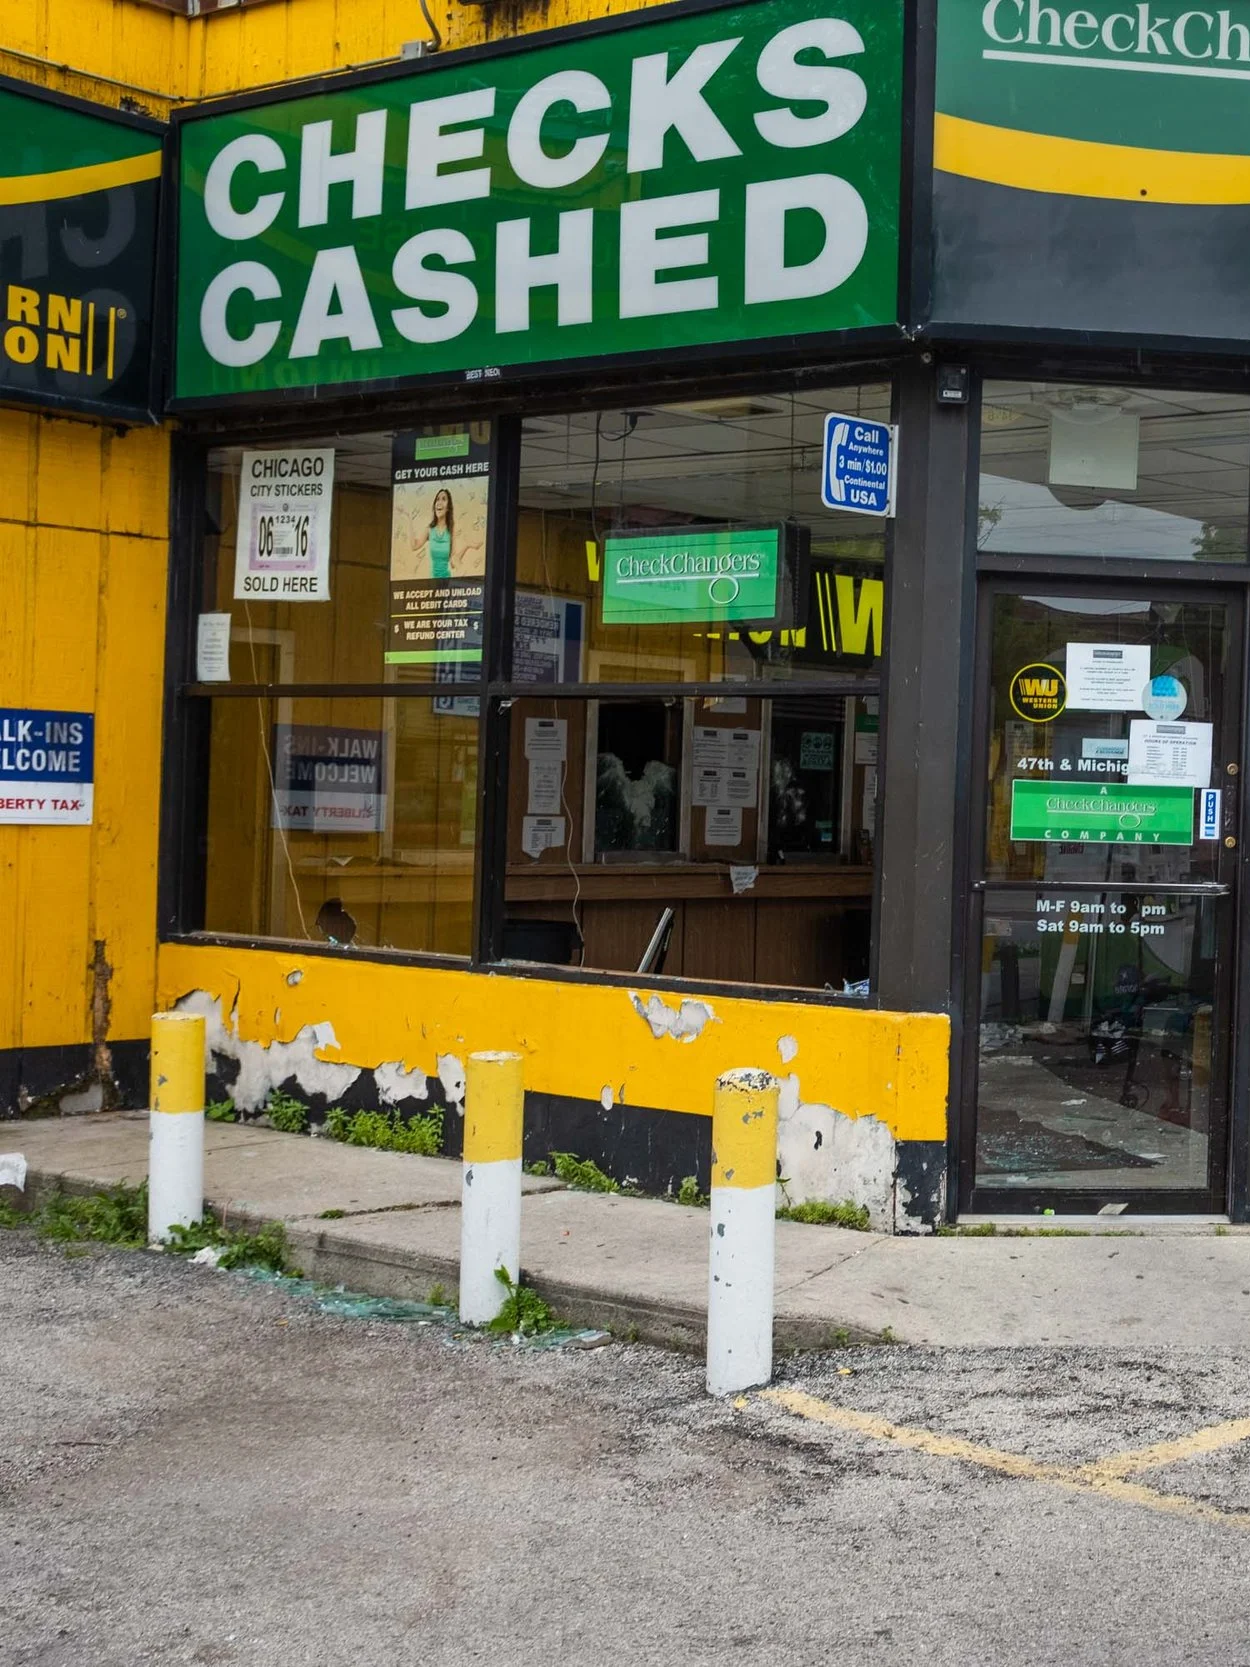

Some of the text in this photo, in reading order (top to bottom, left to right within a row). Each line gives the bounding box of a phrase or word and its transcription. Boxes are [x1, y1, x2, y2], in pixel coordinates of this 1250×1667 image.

[204, 18, 867, 241] CHECKS
[200, 173, 869, 367] CASHED
[855, 427, 879, 444] Call
[848, 442, 884, 457] Anywhere
[252, 457, 324, 478] CHICAGO
[839, 455, 845, 468] 3
[395, 462, 489, 480] GET YOUR CASH HERE
[251, 483, 323, 497] CITY STICKERS
[844, 475, 885, 490] Continental
[850, 489, 877, 506] USA
[259, 515, 309, 557] 06 1234 16
[244, 577, 318, 592] SOLD HERE
[616, 552, 761, 604] CheckChangers
[393, 587, 481, 600] WE ACCEPT AND UNLOAD
[406, 600, 467, 610] ALL DEBIT CARDS
[404, 620, 418, 629] WE
[419, 620, 432, 629] ARE
[432, 619, 453, 628] YOUR
[453, 618, 468, 627] TAX
[406, 630, 465, 640] REFUND CENTER
[1024, 679, 1058, 696] WU
[0, 719, 83, 744] LK-INS
[0, 748, 80, 772] LCOME
[1017, 757, 1054, 770] 47th
[1060, 759, 1072, 771] &
[1100, 786, 1108, 794] A
[51, 799, 80, 811] TAX
[1046, 798, 1156, 829] CheckChangers
[1206, 794, 1216, 822] PUSH
[1045, 829, 1160, 842] COMPANY
[1036, 900, 1166, 917] M-F 9am to pm
[1037, 919, 1165, 936] Sat 9am to 5pm
